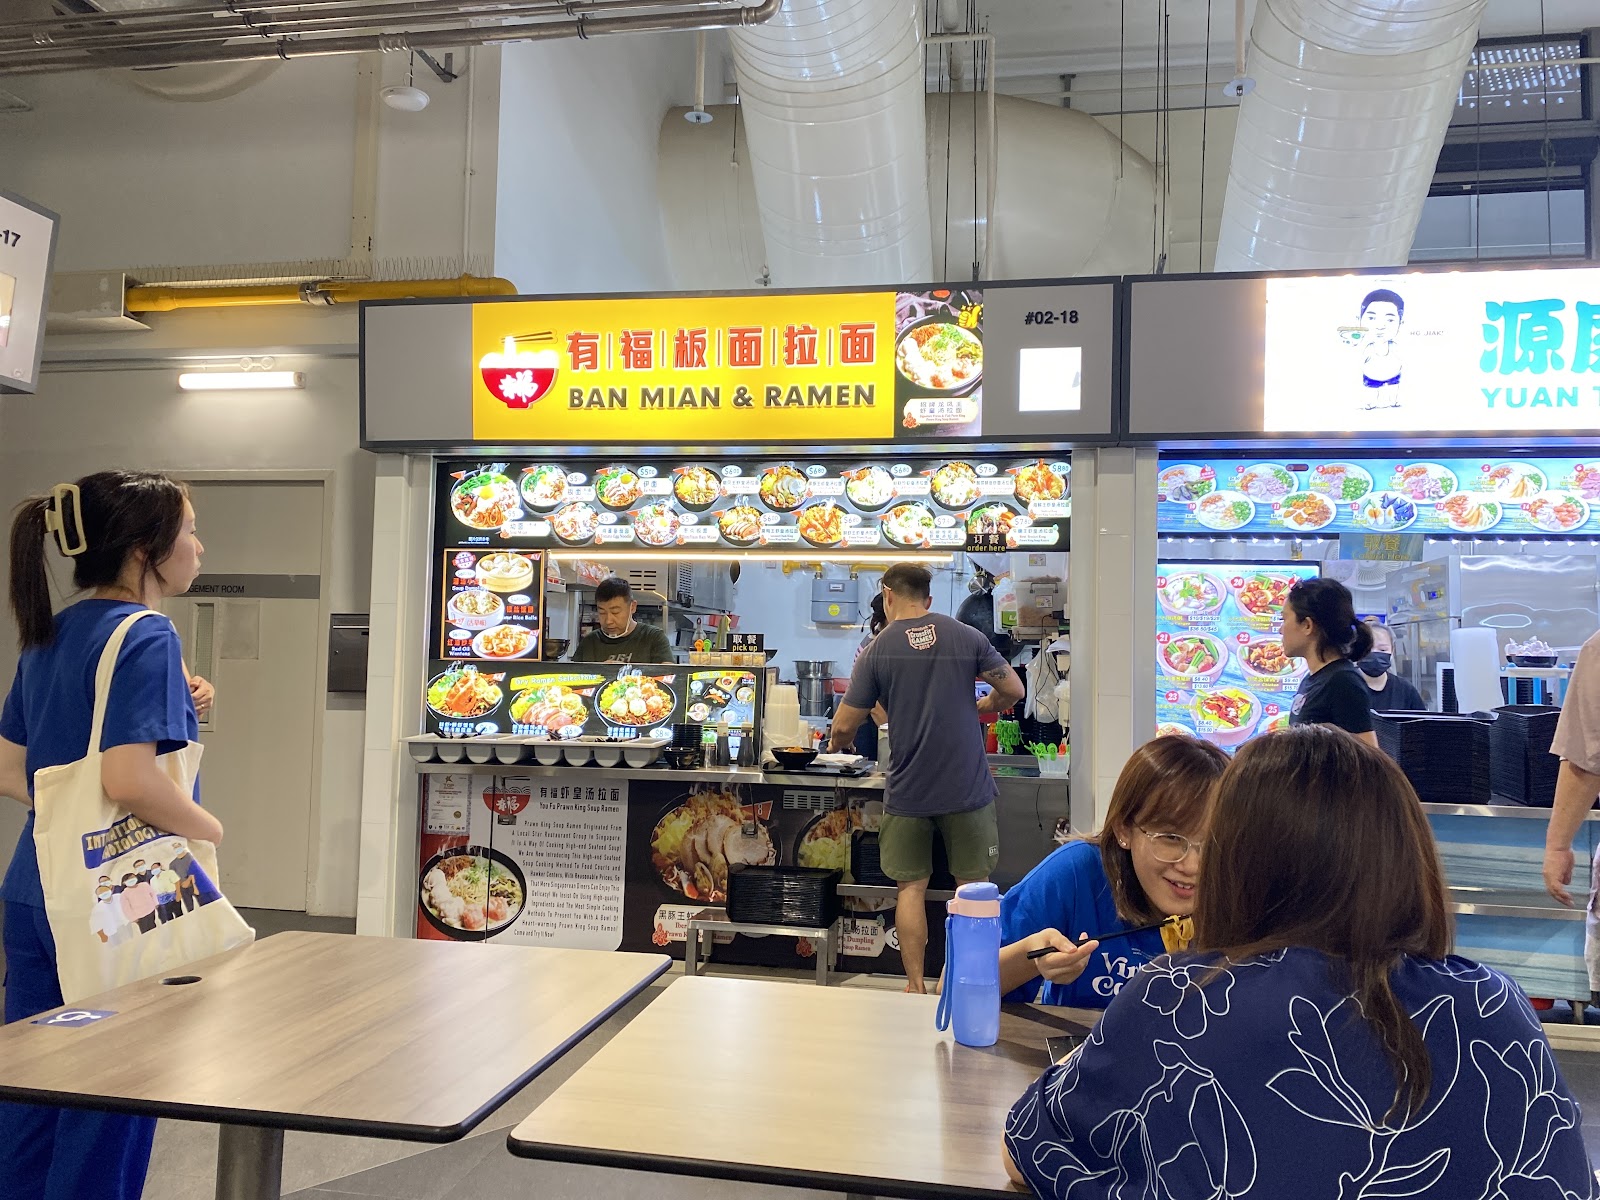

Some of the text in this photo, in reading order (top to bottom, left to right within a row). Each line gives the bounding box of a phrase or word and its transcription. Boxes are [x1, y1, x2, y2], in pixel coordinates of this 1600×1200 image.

[1024, 310, 1079, 325] #02-18
[566, 322, 875, 370] 有福板面拉面
[569, 384, 875, 408] BAN MIAN & RAMEN
[1481, 386, 1579, 408] YUAN
[974, 535, 1000, 544] 订餐
[1364, 530, 1400, 551] 取餐
[1157, 579, 1166, 587] 19
[732, 635, 757, 644] 取餐
[1159, 634, 1169, 642] 21
[1239, 634, 1249, 642] 22
[732, 644, 747, 652] pick
[1267, 706, 1277, 714] 25
[540, 786, 619, 801] 有福虾皇汤拉面
[575, 803, 586, 812] King
[587, 804, 600, 813] Soup
[847, 936, 874, 944] Dumpling
